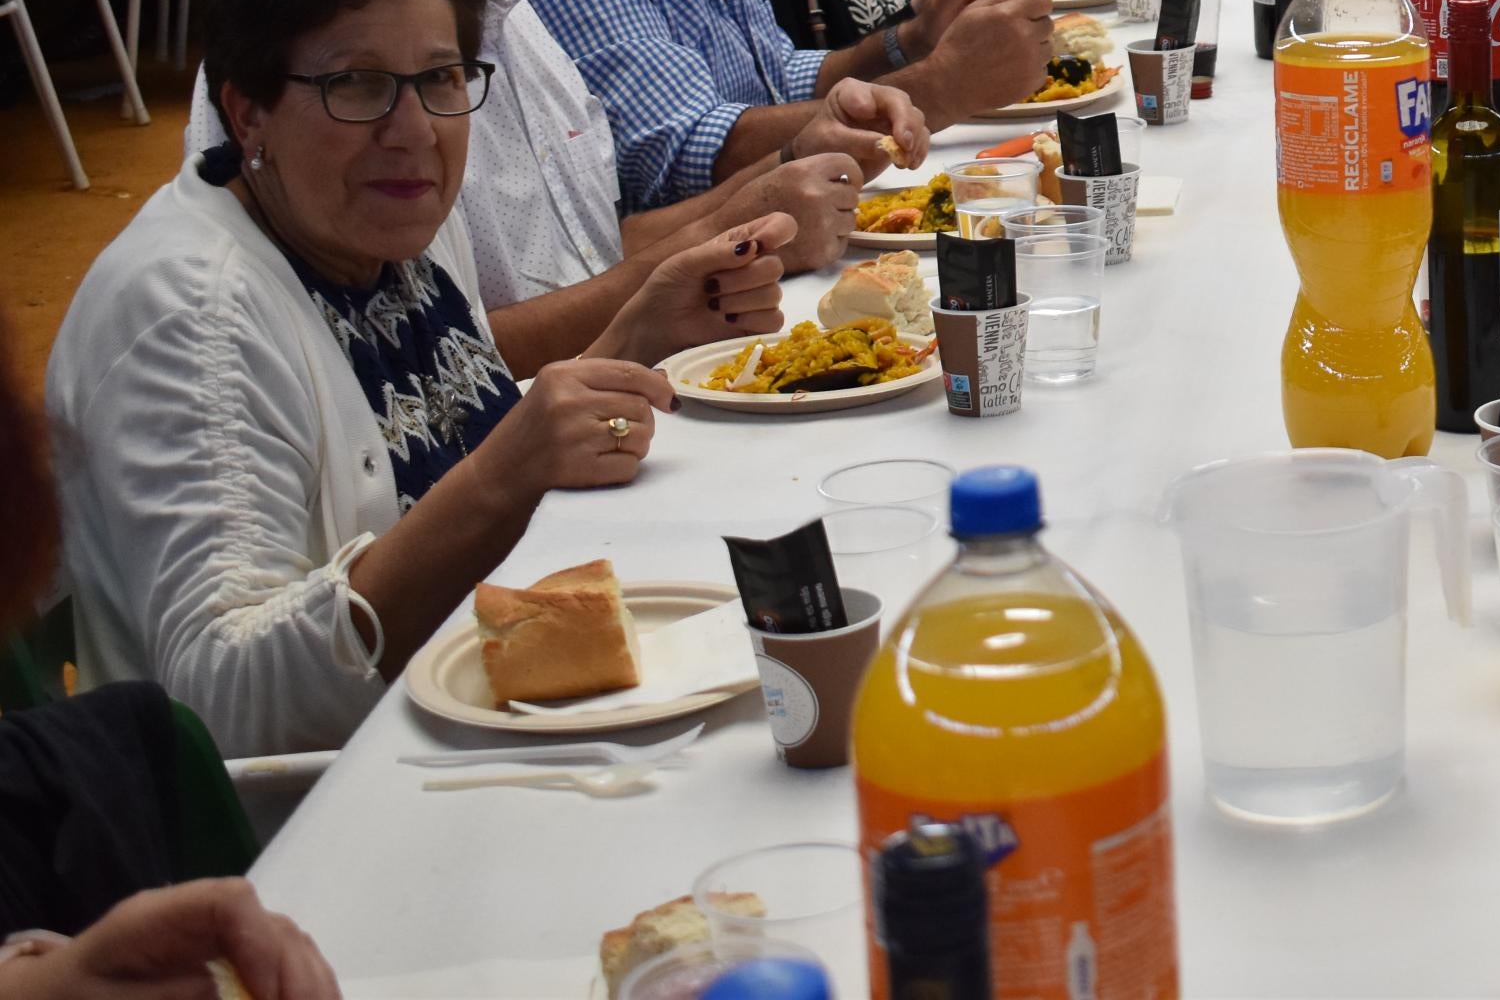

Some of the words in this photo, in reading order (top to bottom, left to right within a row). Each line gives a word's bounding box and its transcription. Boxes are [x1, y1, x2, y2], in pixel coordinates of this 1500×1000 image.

[1167, 53, 1179, 80] VIENNA
[1341, 71, 1360, 191] RECÍCLAME
[983, 312, 1001, 354] VIENNA
